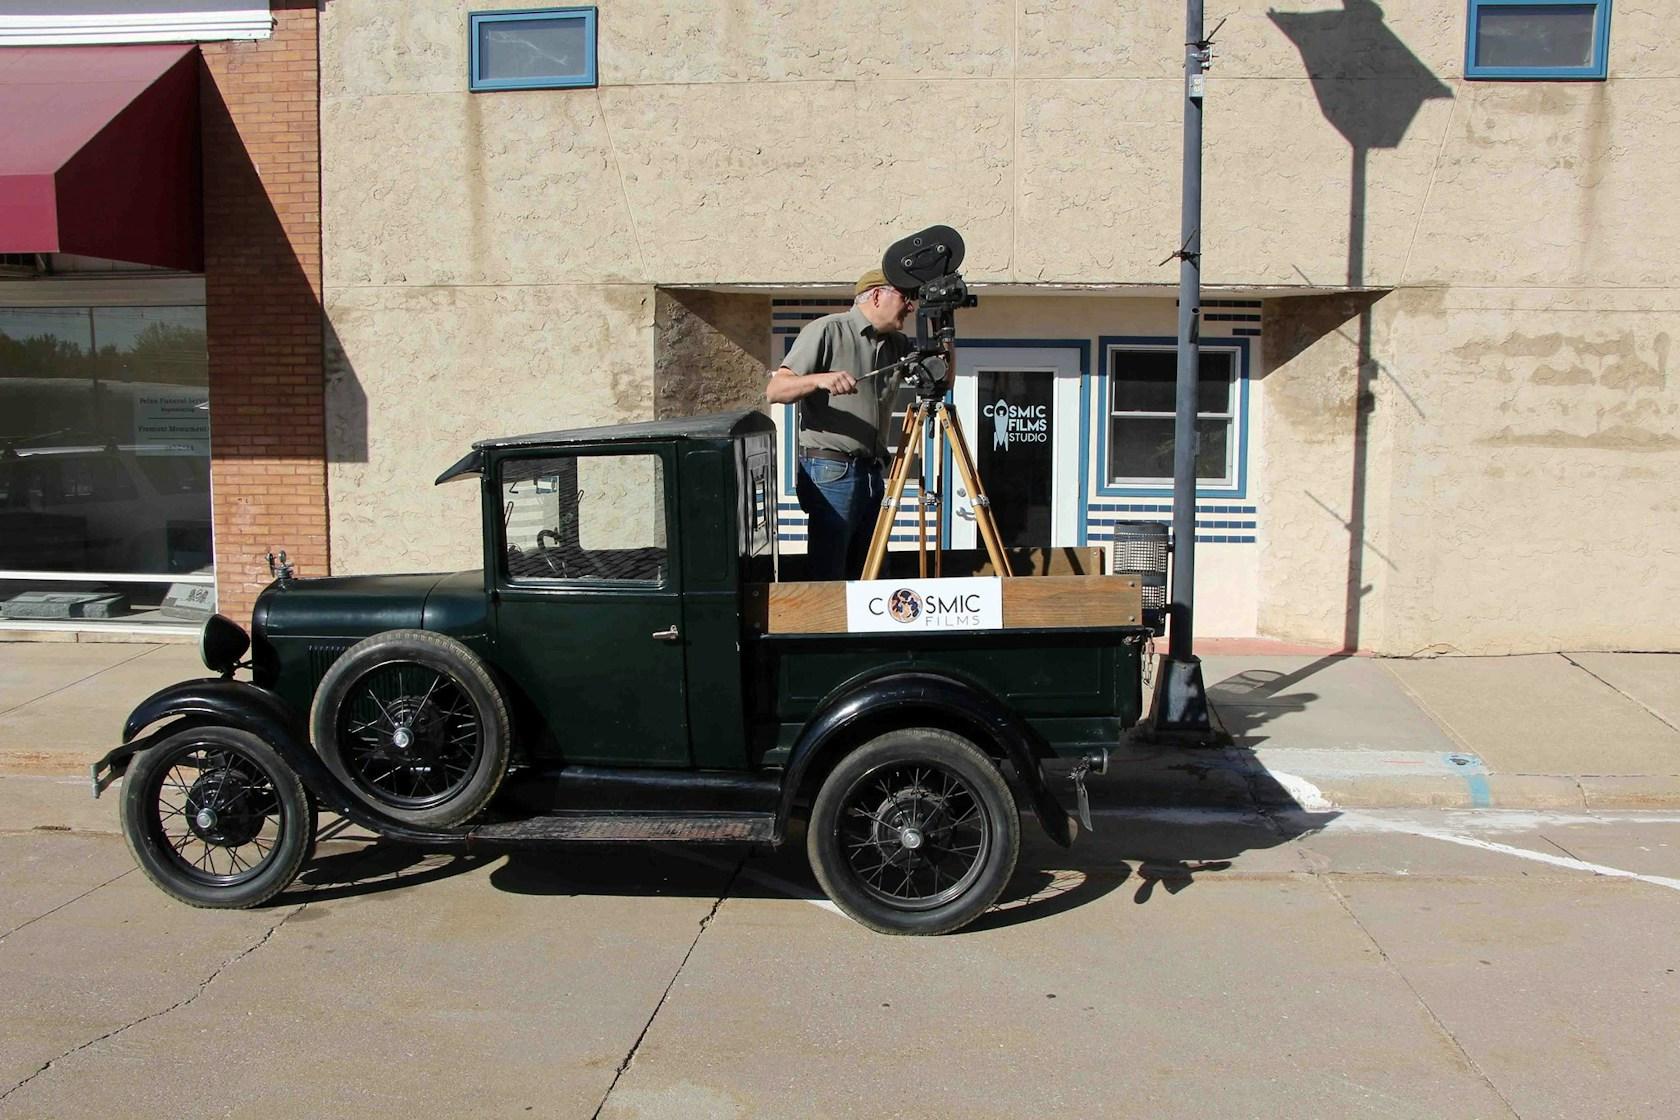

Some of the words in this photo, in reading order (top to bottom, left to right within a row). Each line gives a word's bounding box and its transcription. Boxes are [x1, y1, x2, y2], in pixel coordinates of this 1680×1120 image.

[1008, 419, 1047, 432] FILMS
[1009, 433, 1048, 443] STUDIO
[925, 615, 981, 627] FILMS
